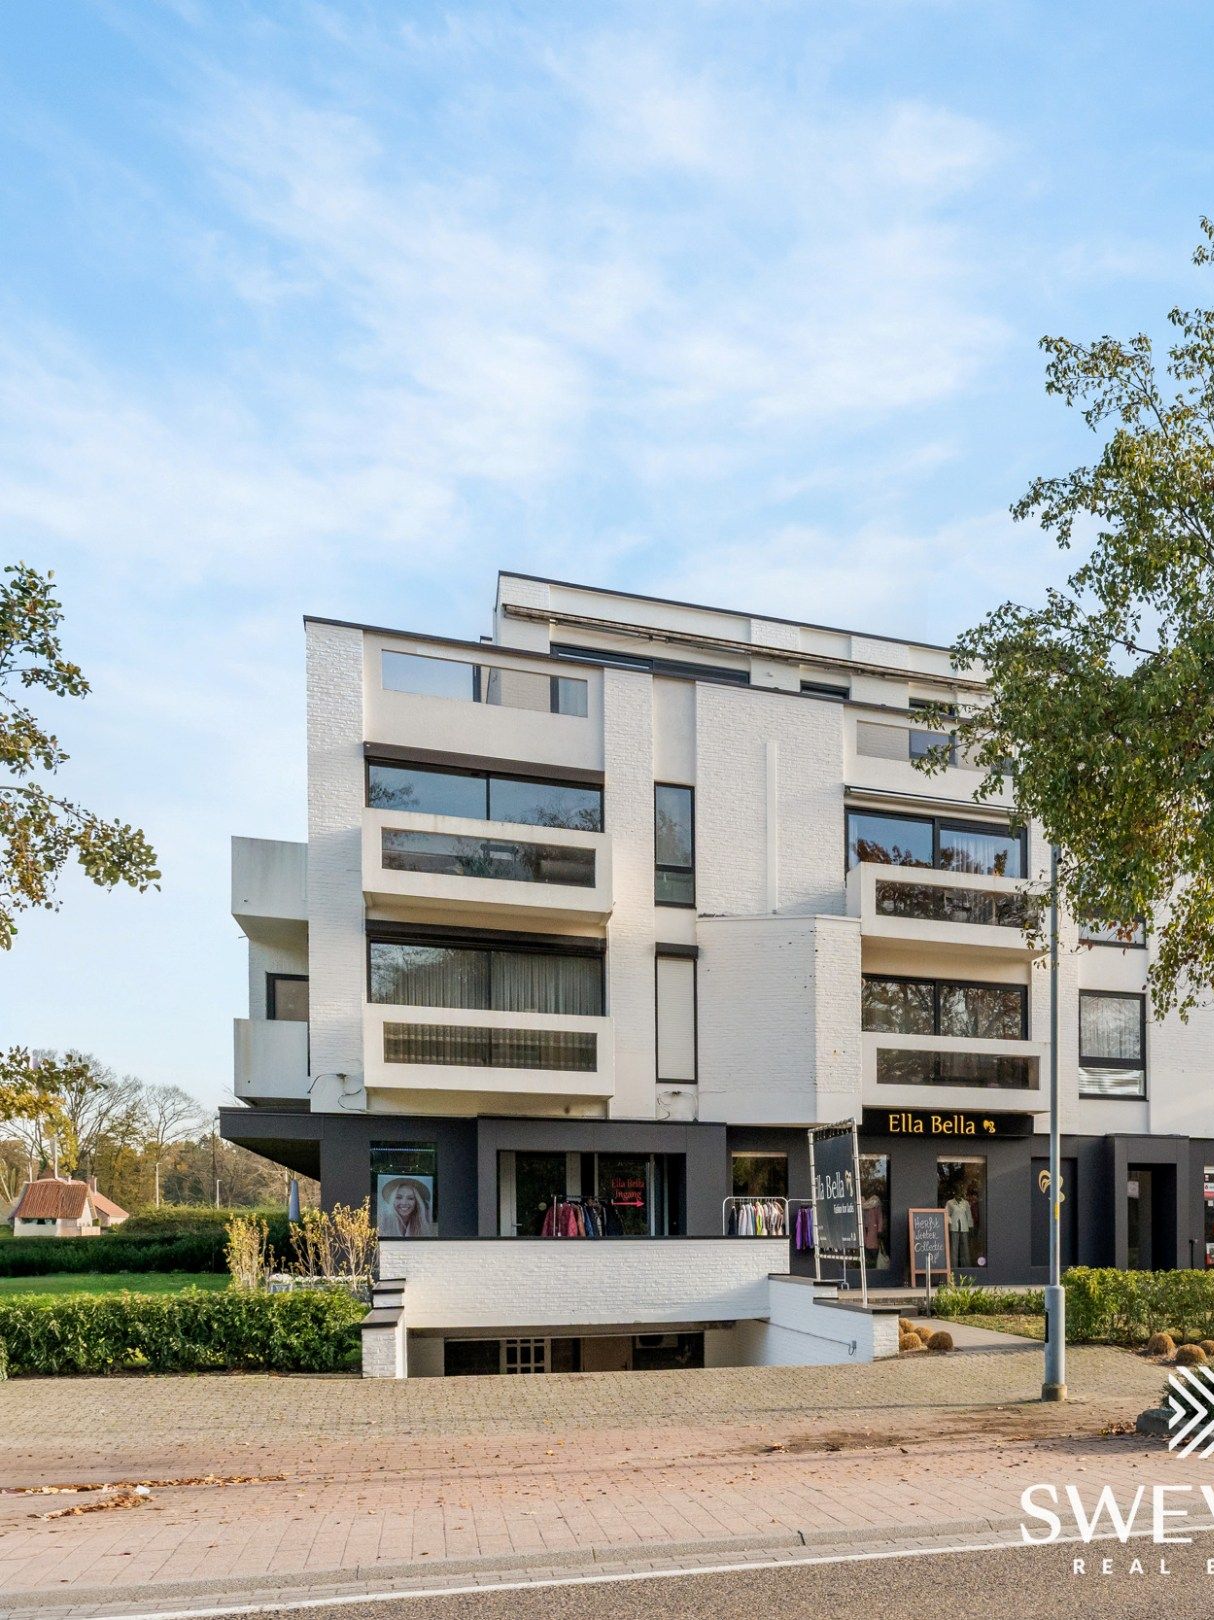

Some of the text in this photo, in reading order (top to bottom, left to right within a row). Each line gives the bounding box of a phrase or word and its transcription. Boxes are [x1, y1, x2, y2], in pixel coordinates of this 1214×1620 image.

[889, 1113, 975, 1135] Ella Bella
[825, 1171, 846, 1199] Bella
